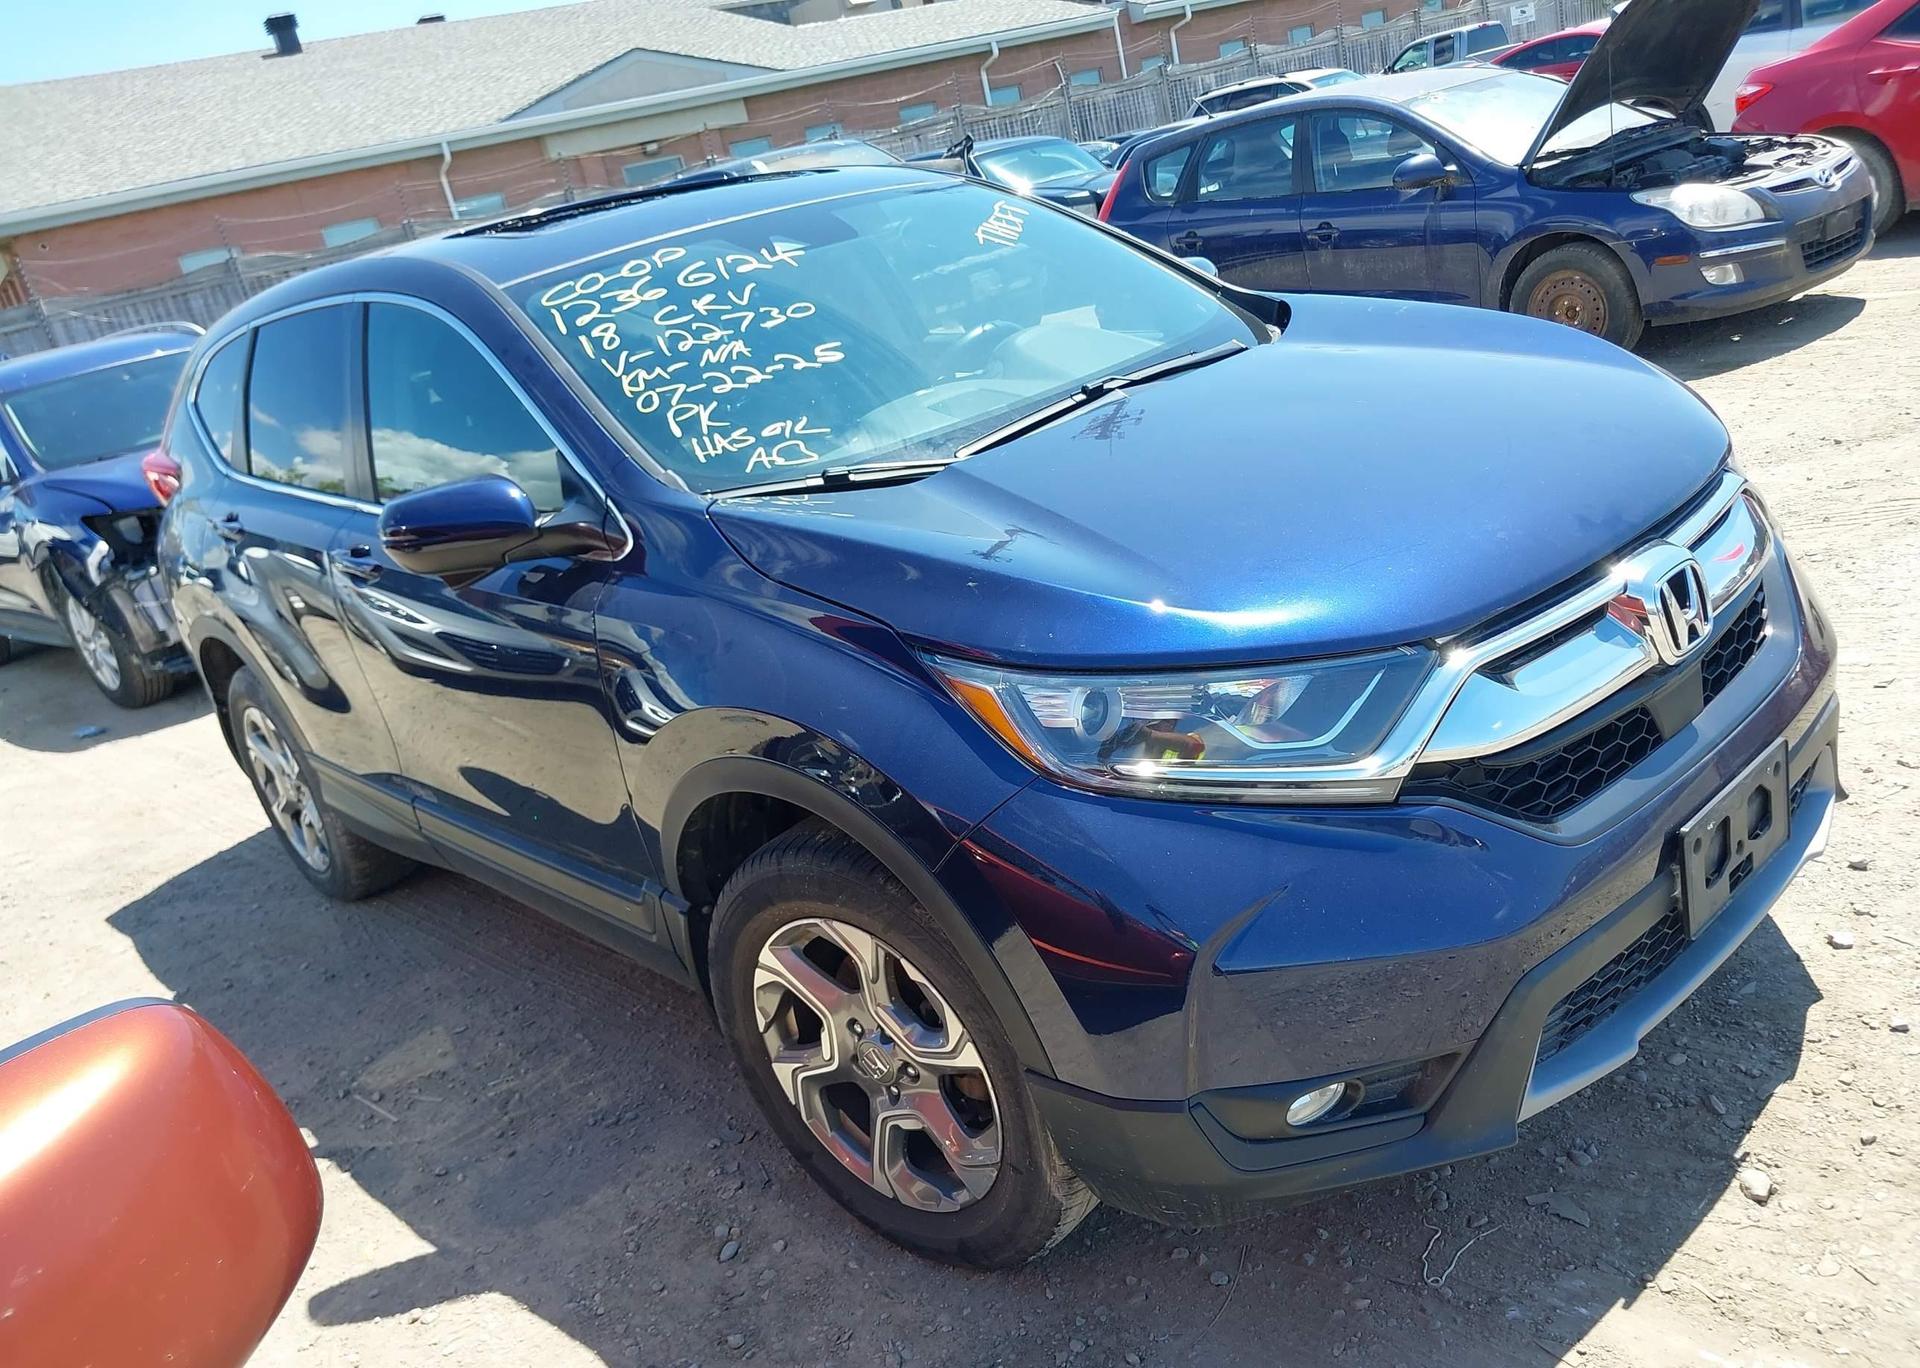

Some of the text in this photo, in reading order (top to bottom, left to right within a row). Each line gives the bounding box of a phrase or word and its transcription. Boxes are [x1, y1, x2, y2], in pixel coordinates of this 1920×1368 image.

[974, 200, 1029, 247] THEFT
[551, 276, 667, 335] 1236
[578, 322, 620, 360] 18
[667, 401, 731, 438] PK
[691, 427, 756, 463] HAS
